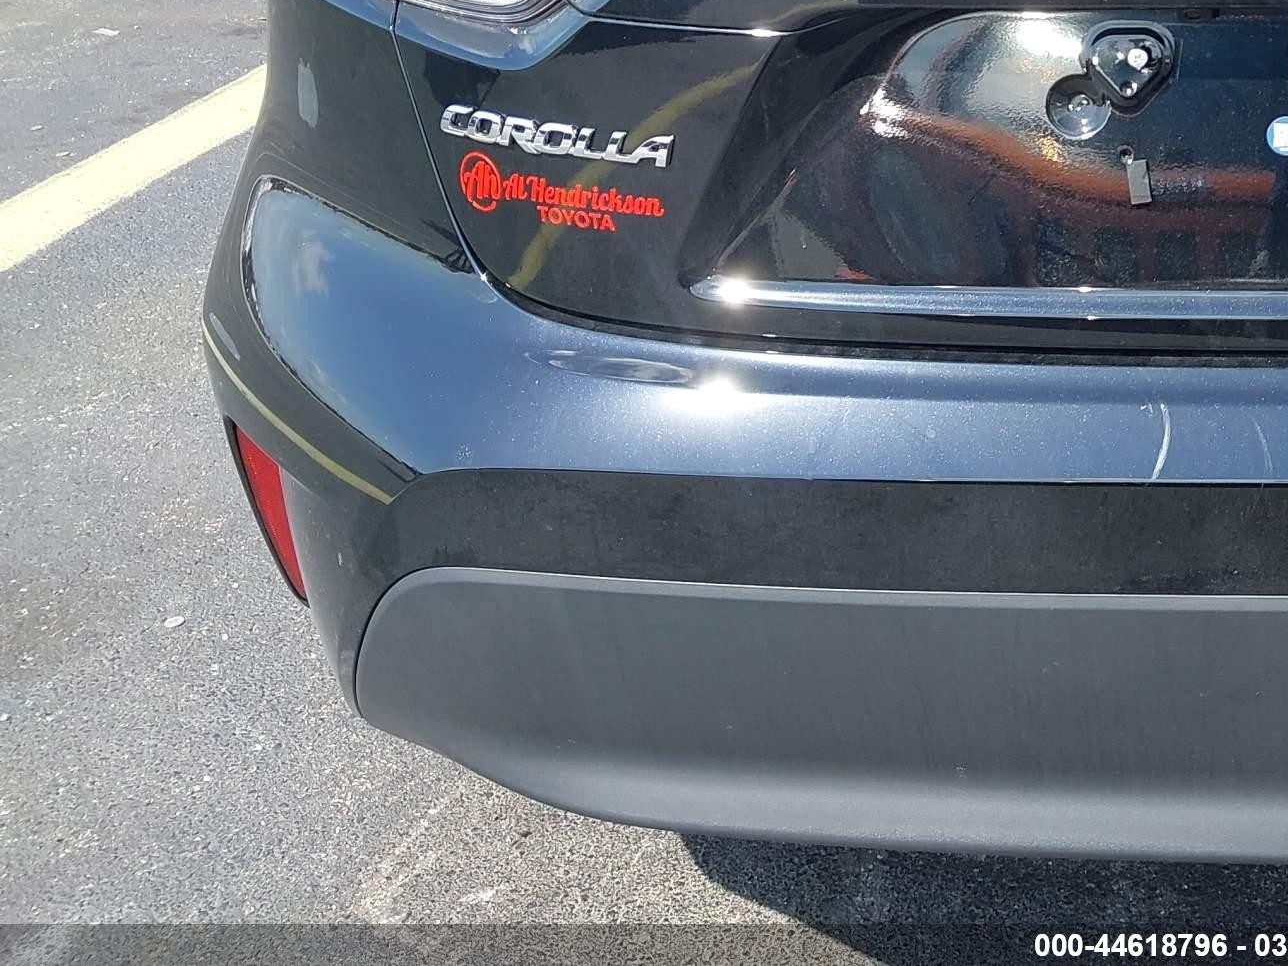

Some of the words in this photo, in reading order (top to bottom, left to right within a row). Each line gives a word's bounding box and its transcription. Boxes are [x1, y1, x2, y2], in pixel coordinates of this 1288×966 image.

[439, 103, 677, 169] COROLLA
[502, 173, 528, 201] Al
[525, 176, 665, 217] Hendrickson
[537, 205, 617, 232] TOYOTA
